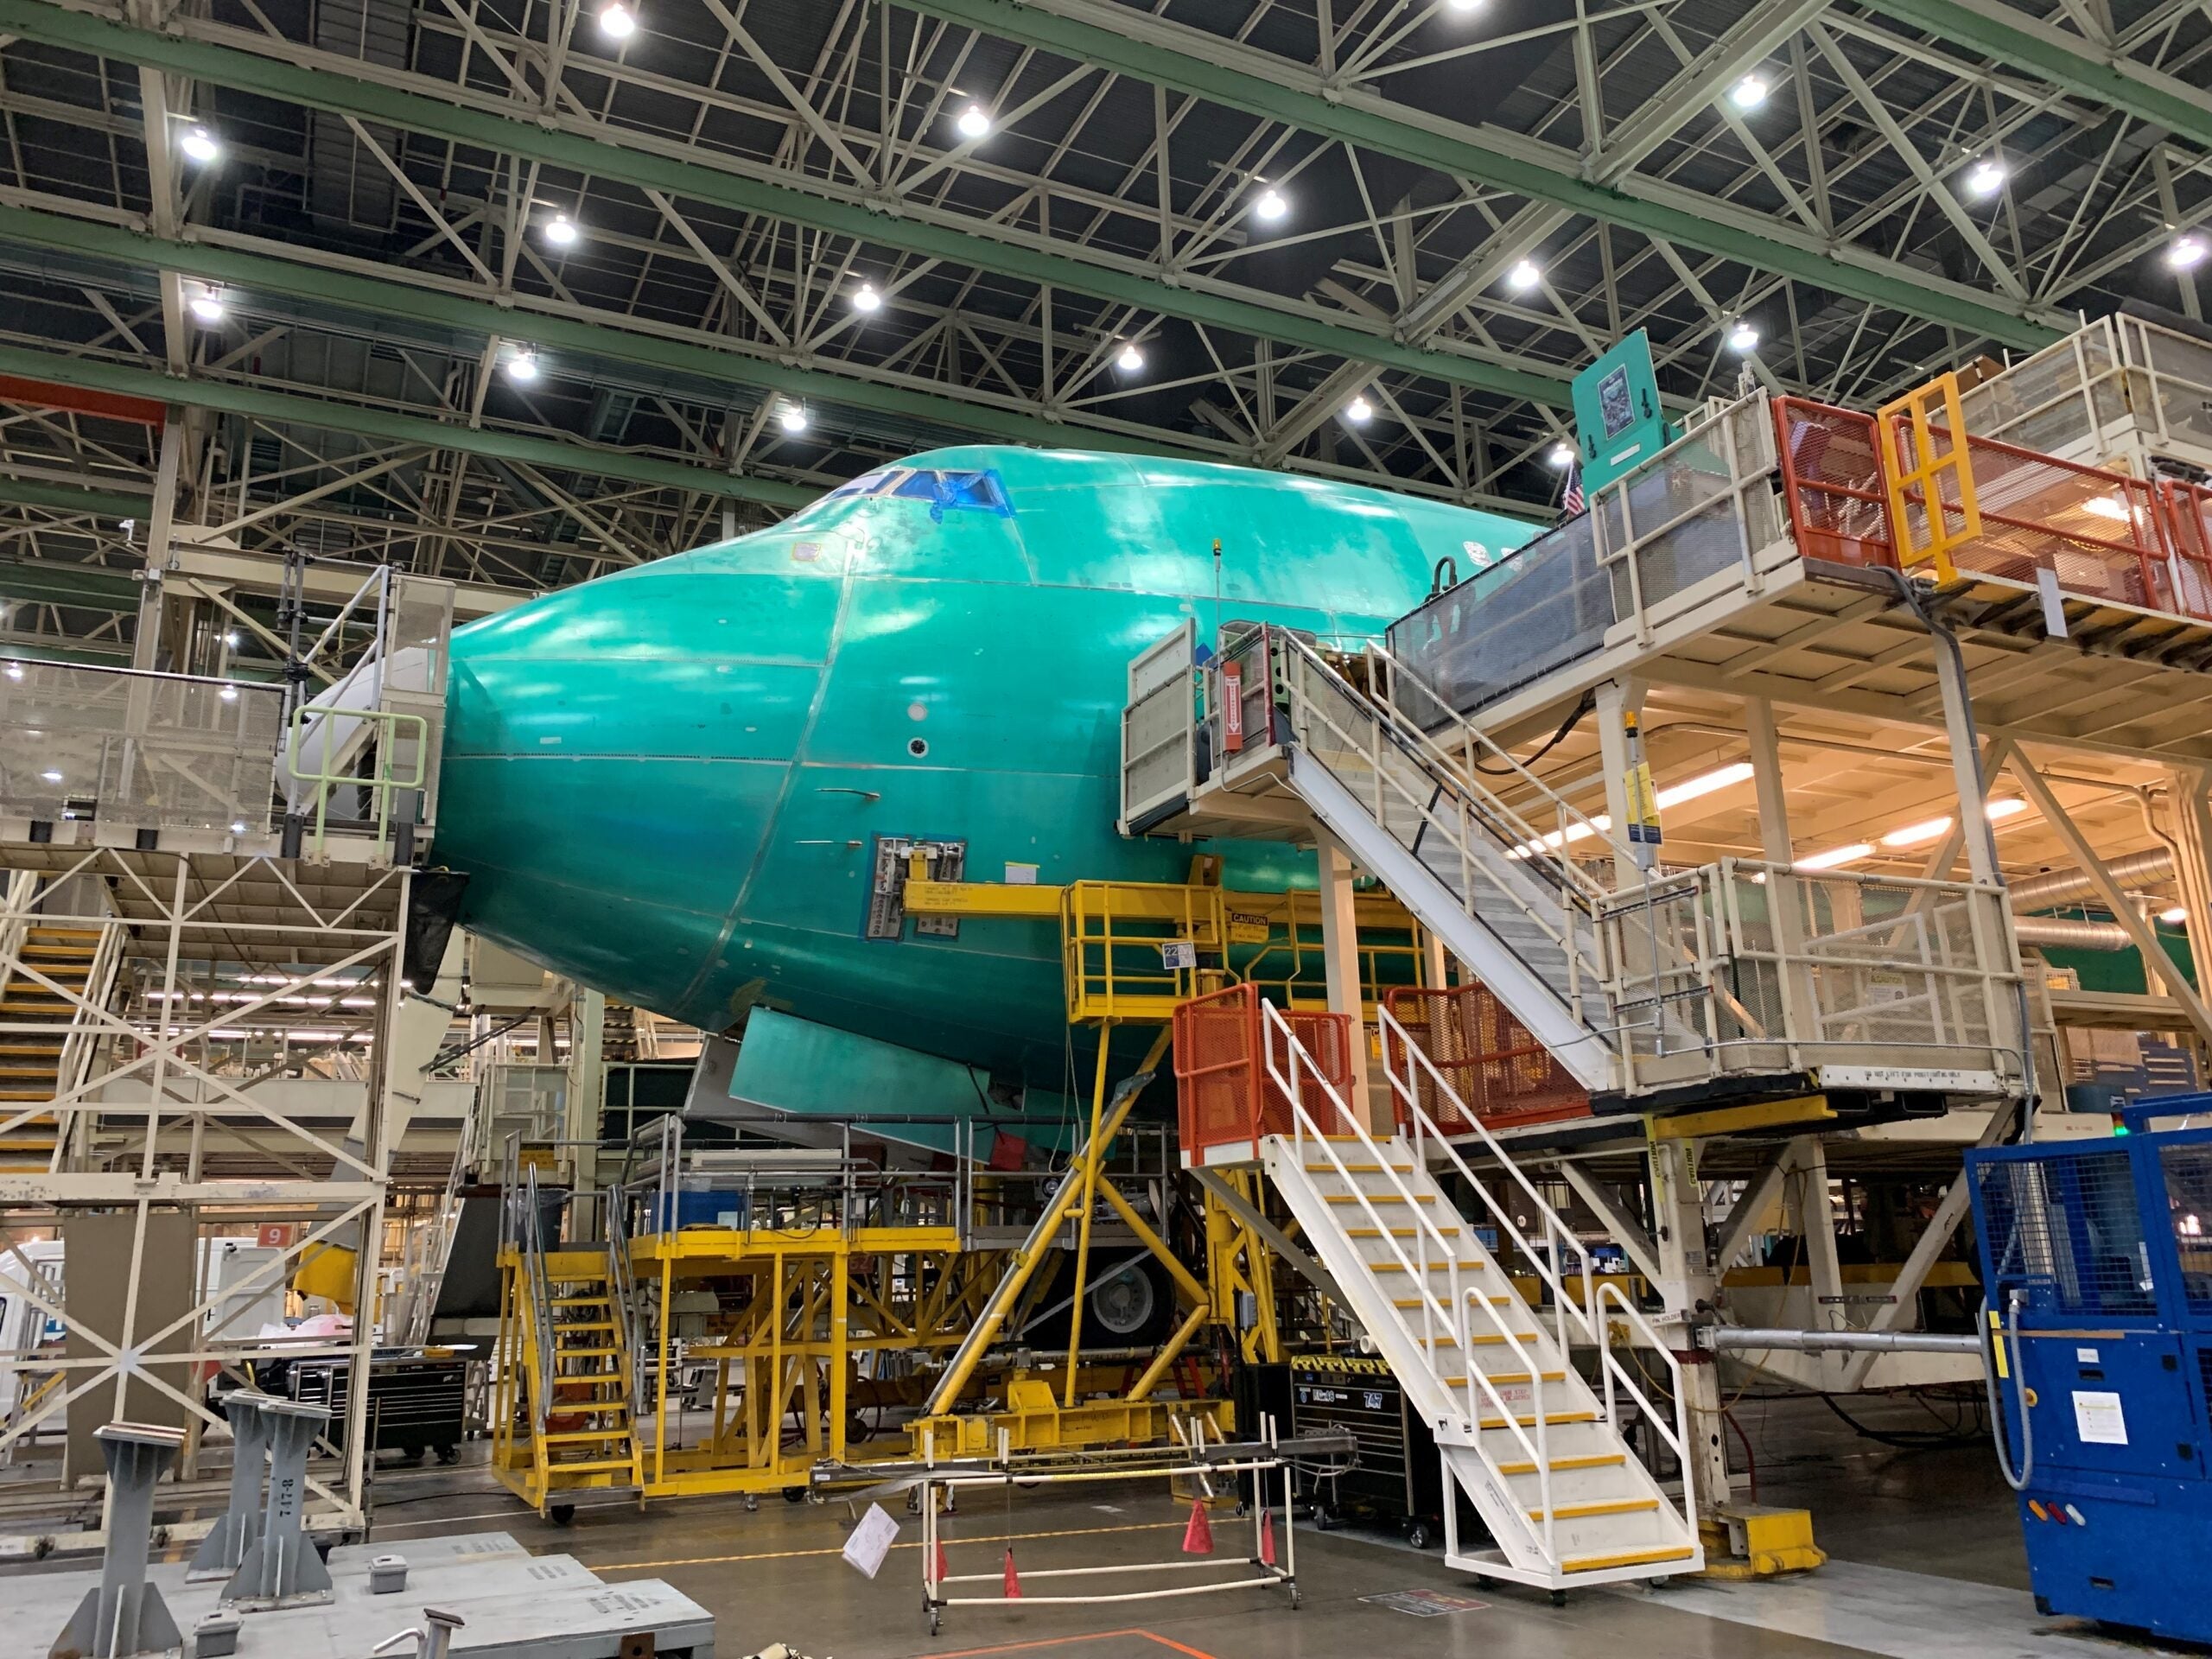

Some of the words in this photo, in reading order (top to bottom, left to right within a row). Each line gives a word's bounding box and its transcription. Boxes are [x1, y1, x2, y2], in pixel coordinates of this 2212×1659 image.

[1233, 913, 1267, 925] CAUTION
[1165, 946, 1178, 957] 22
[1649, 1141, 1660, 1178] CAUTION
[1685, 1148, 1696, 1185] CAUTION
[269, 1228, 281, 1244] 9
[1363, 1392, 1382, 1408] 747
